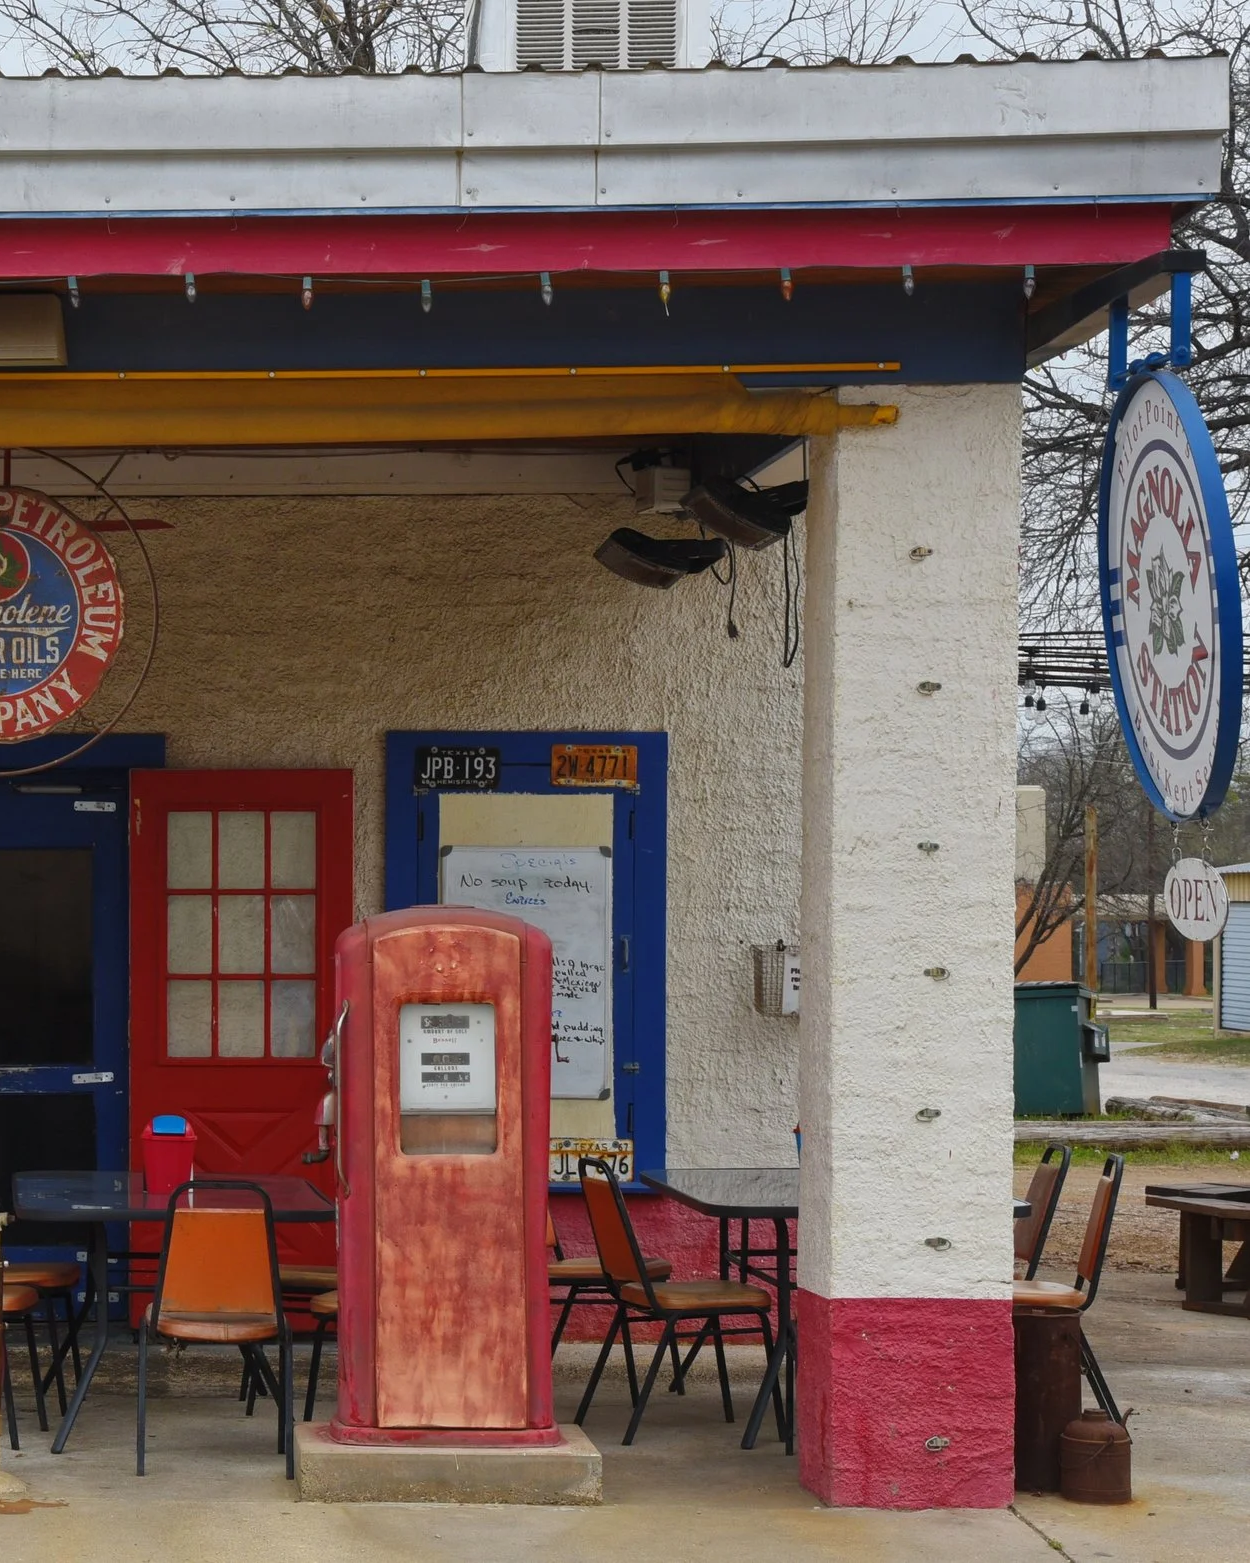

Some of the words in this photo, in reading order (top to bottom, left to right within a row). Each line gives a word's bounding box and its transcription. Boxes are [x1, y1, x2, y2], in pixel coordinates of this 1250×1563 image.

[1118, 409, 1144, 485] Pilot
[1126, 464, 1202, 611] MAGNOLIA
[12, 636, 59, 664] OILS
[11, 668, 42, 680] HERE
[1137, 621, 1209, 736] STATION
[1135, 707, 1160, 780] Best
[1165, 768, 1194, 811] Kept
[460, 873, 483, 887] No
[491, 878, 528, 891] soup
[1170, 878, 1219, 922] OPEN
[573, 1143, 608, 1151] TEXAS
[618, 1143, 629, 1151] 67
